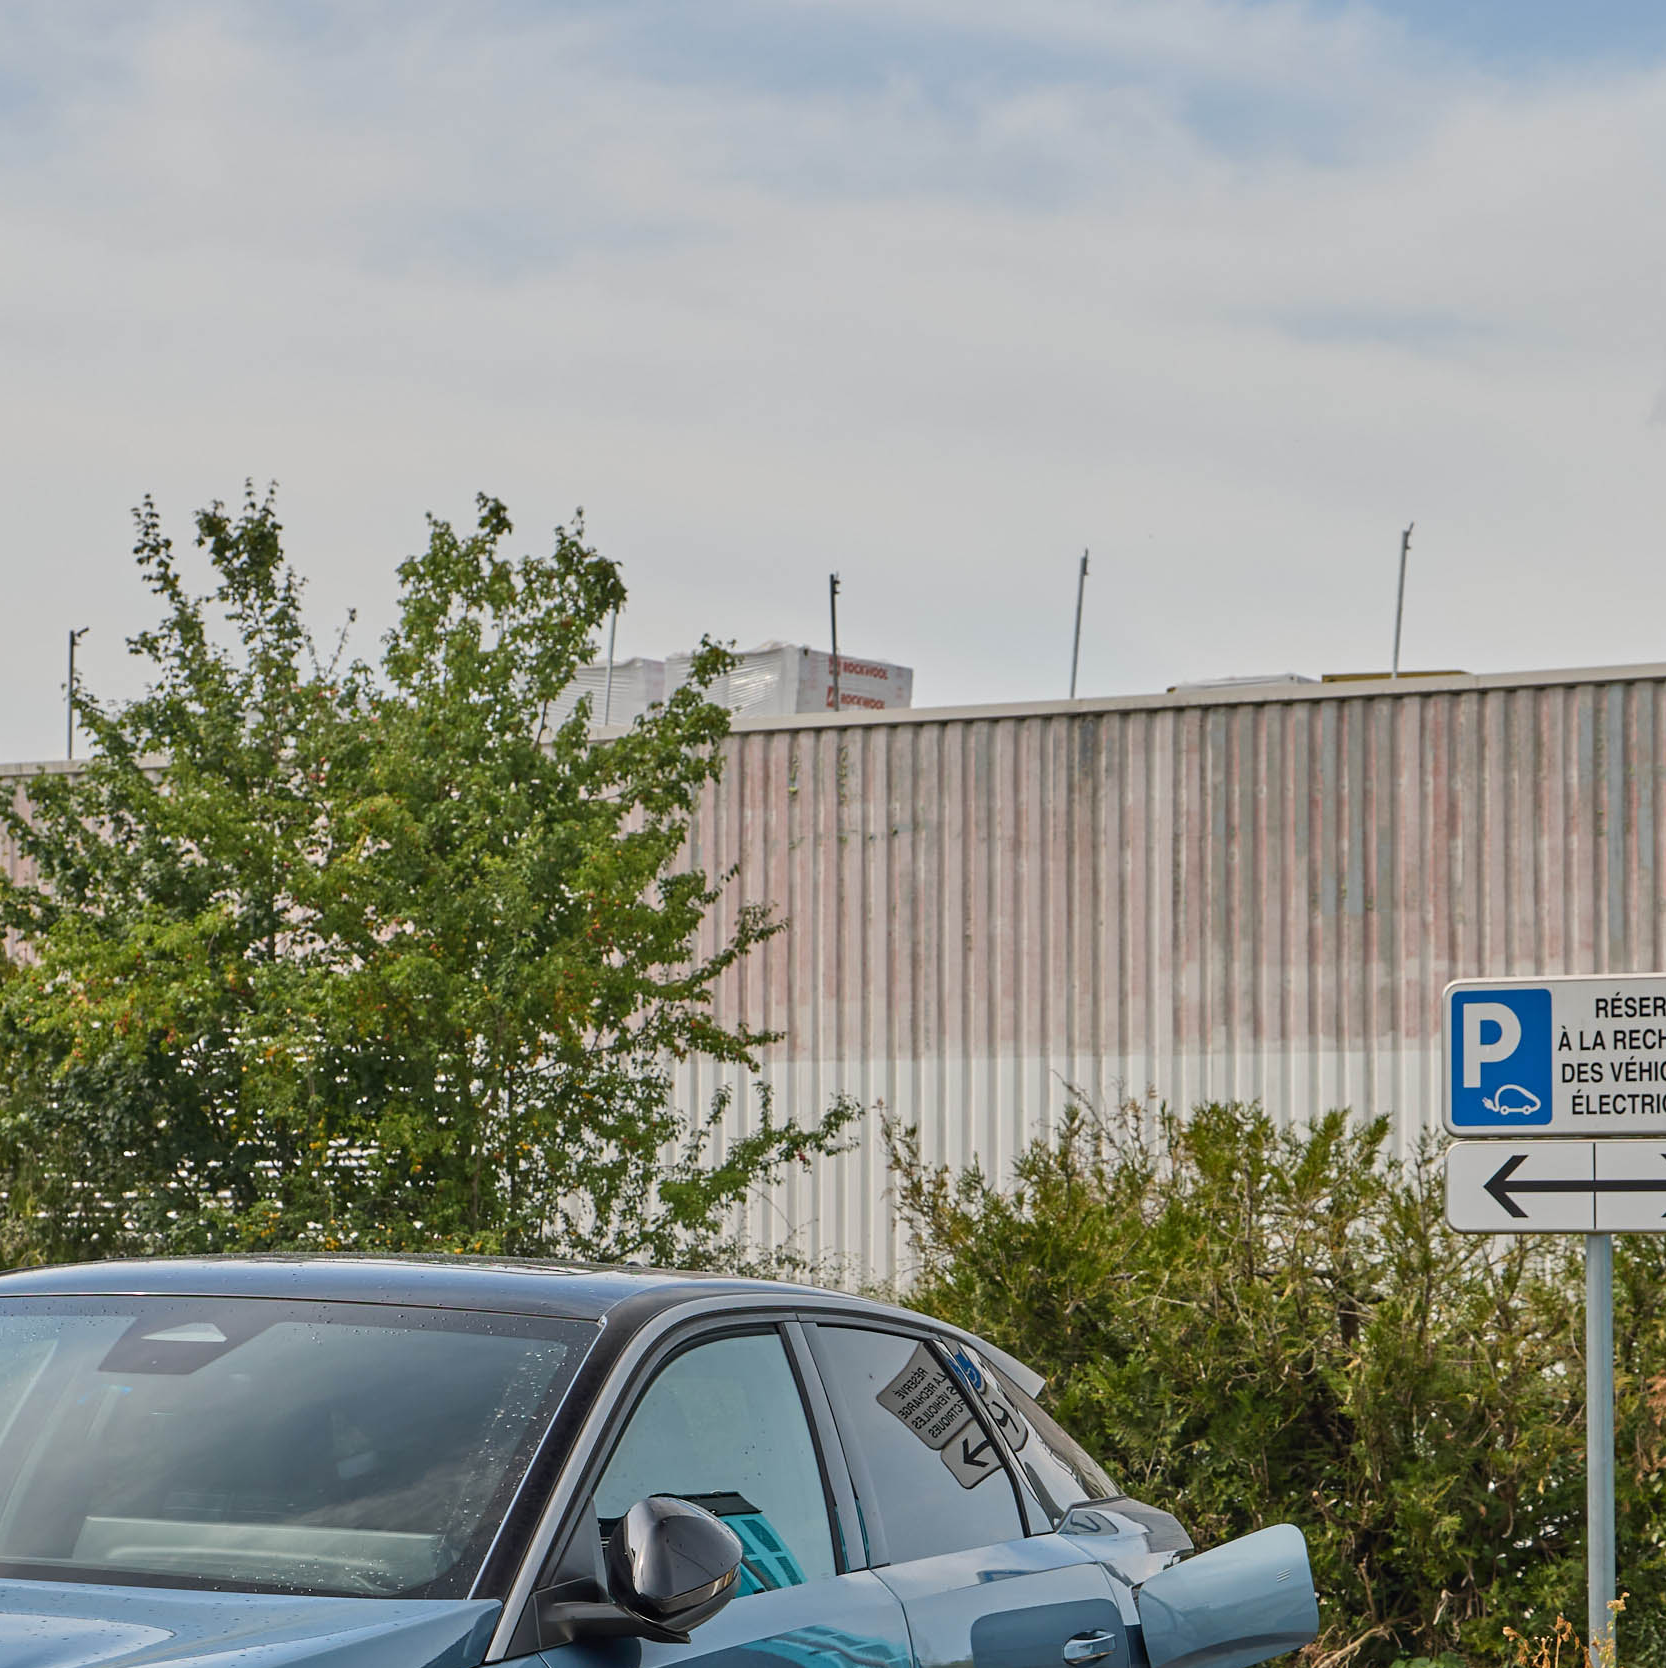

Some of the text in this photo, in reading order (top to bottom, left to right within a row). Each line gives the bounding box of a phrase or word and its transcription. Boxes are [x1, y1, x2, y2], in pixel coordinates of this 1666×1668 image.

[1463, 1002, 1522, 1088] P
[1557, 1025, 1572, 1051] À
[1579, 1029, 1606, 1051] LA
[1562, 1062, 1604, 1083] DES
